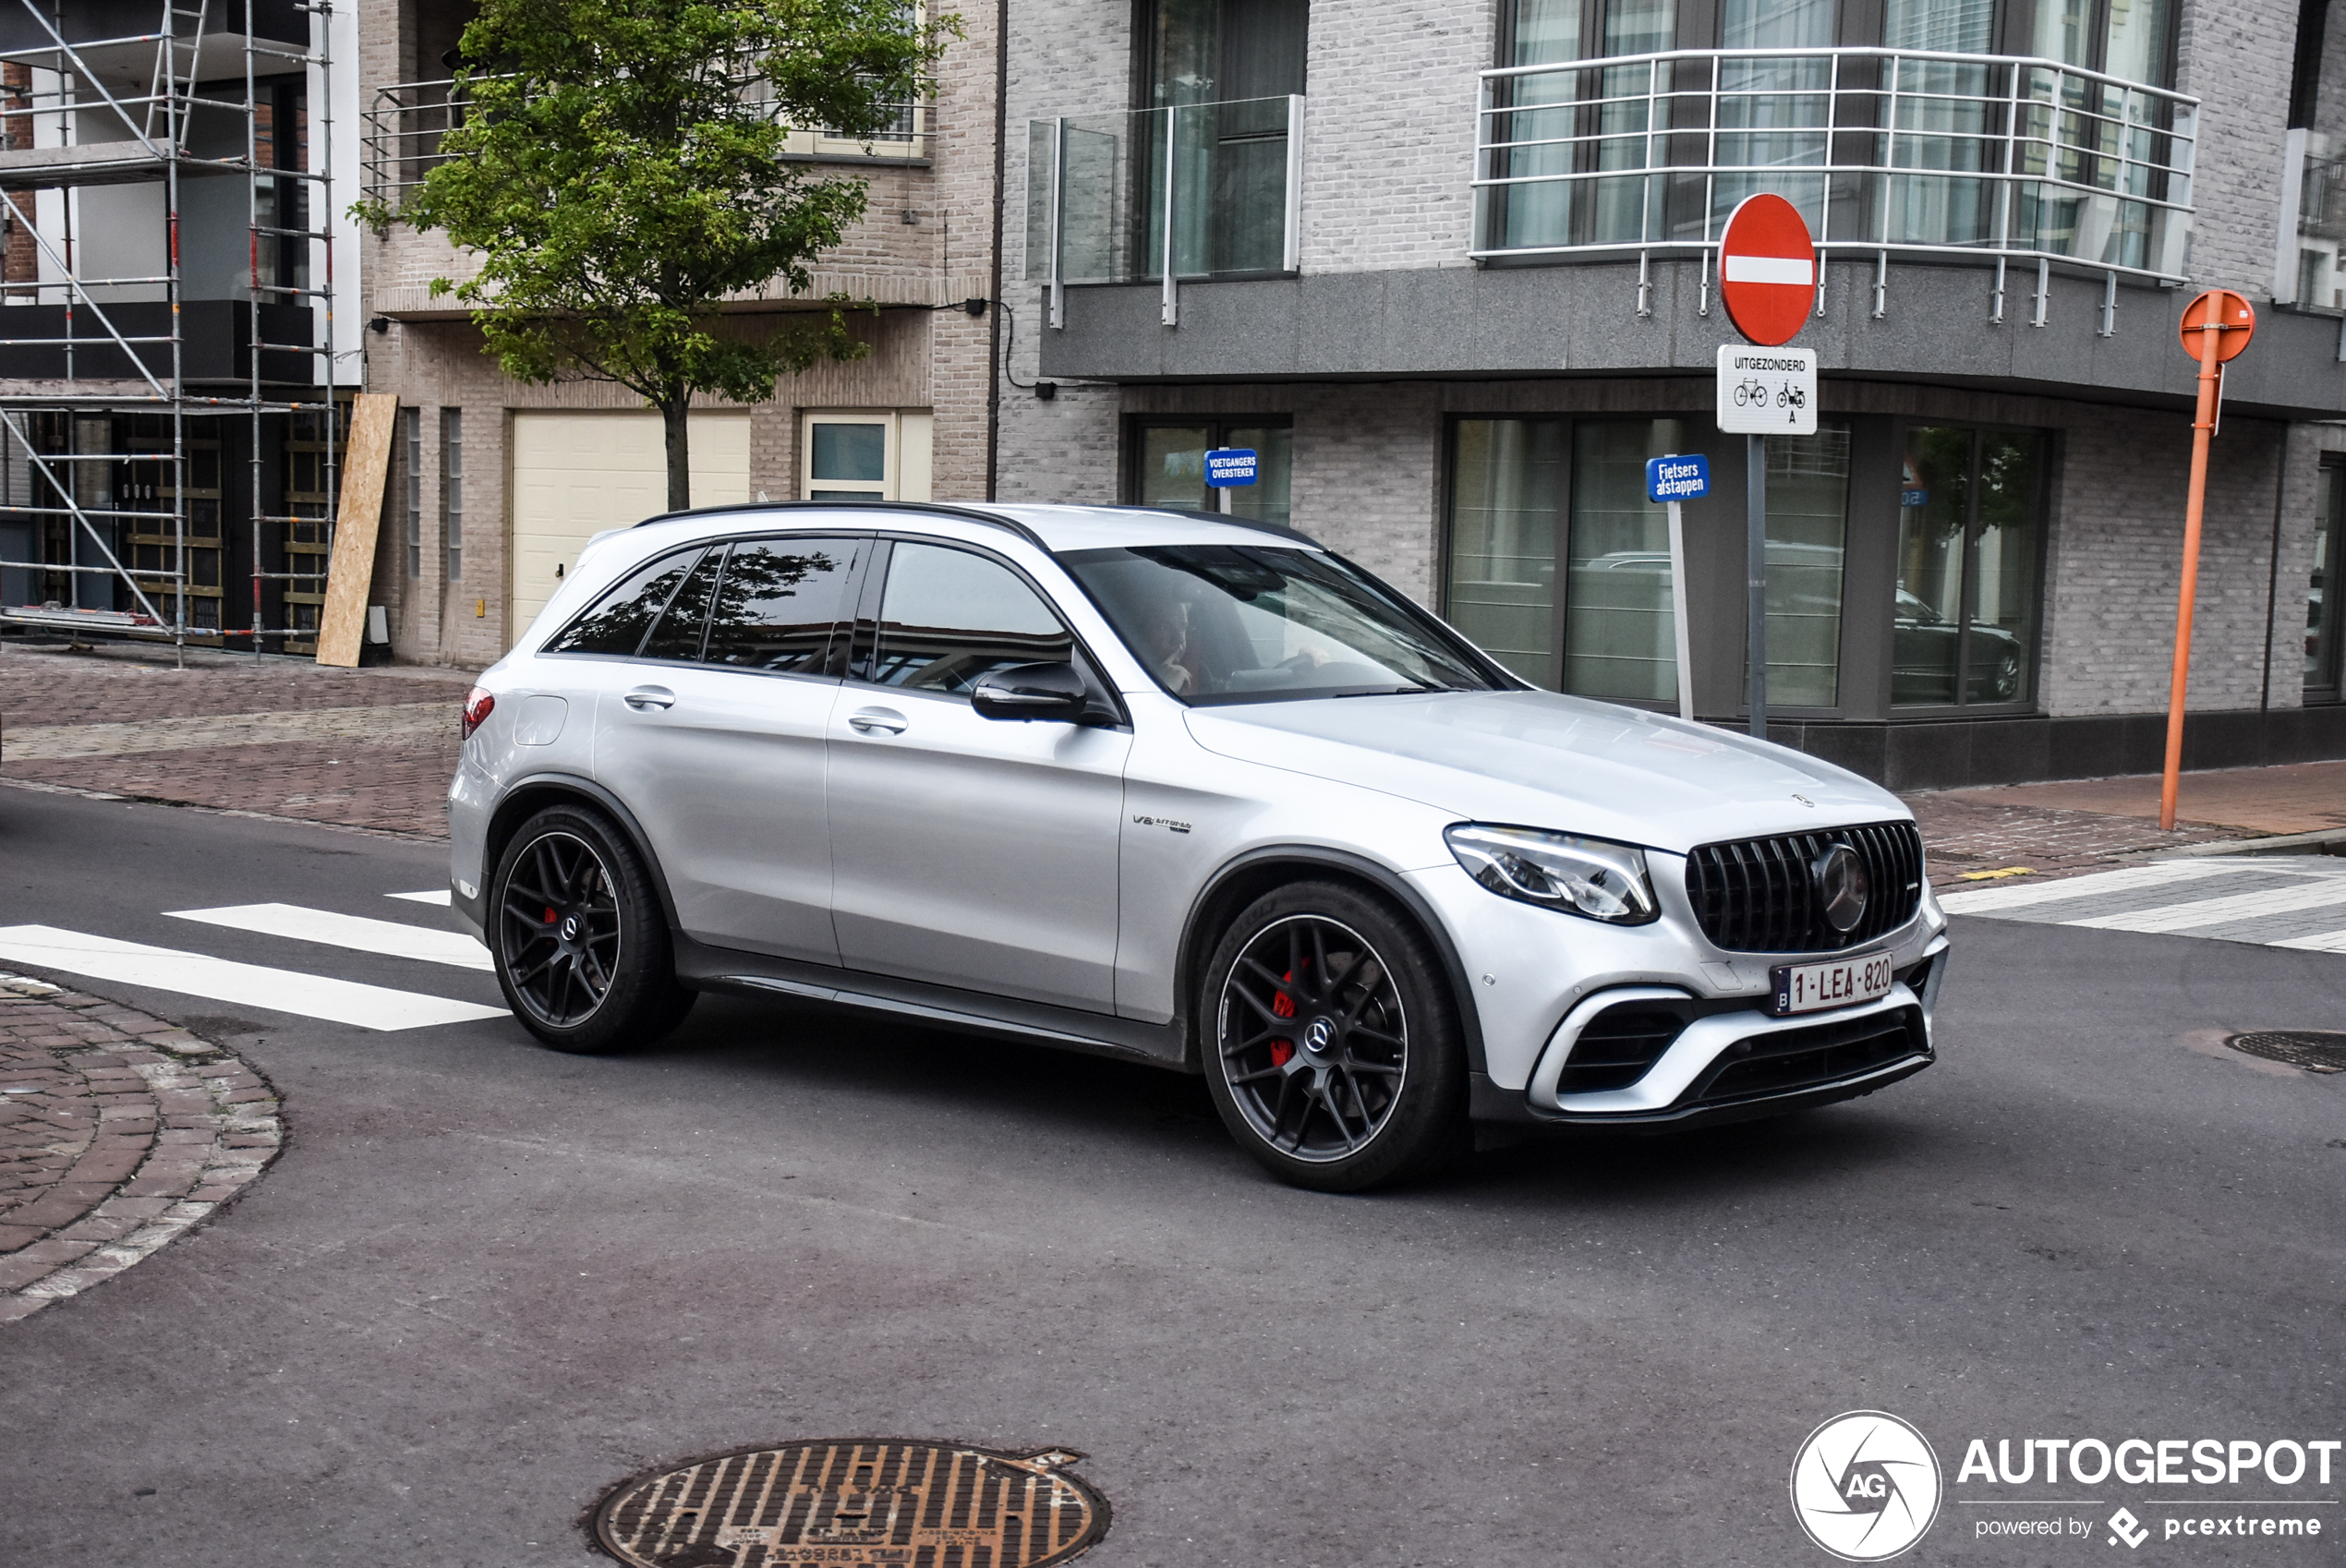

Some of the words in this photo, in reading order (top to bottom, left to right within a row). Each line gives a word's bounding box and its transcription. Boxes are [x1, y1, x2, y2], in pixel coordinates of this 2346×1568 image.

[1735, 356, 1806, 371] UITGEZONDERD
[1788, 410, 1796, 424] A
[1209, 456, 1256, 468] VOETGANGERS
[1212, 467, 1254, 478] OVERSTEKEN
[1658, 463, 1699, 480] Fietsers
[1656, 478, 1704, 496] afstappen
[1133, 814, 1154, 825] V8
[1796, 958, 1890, 1004] 1-LEA-820
[1779, 993, 1788, 1007] B
